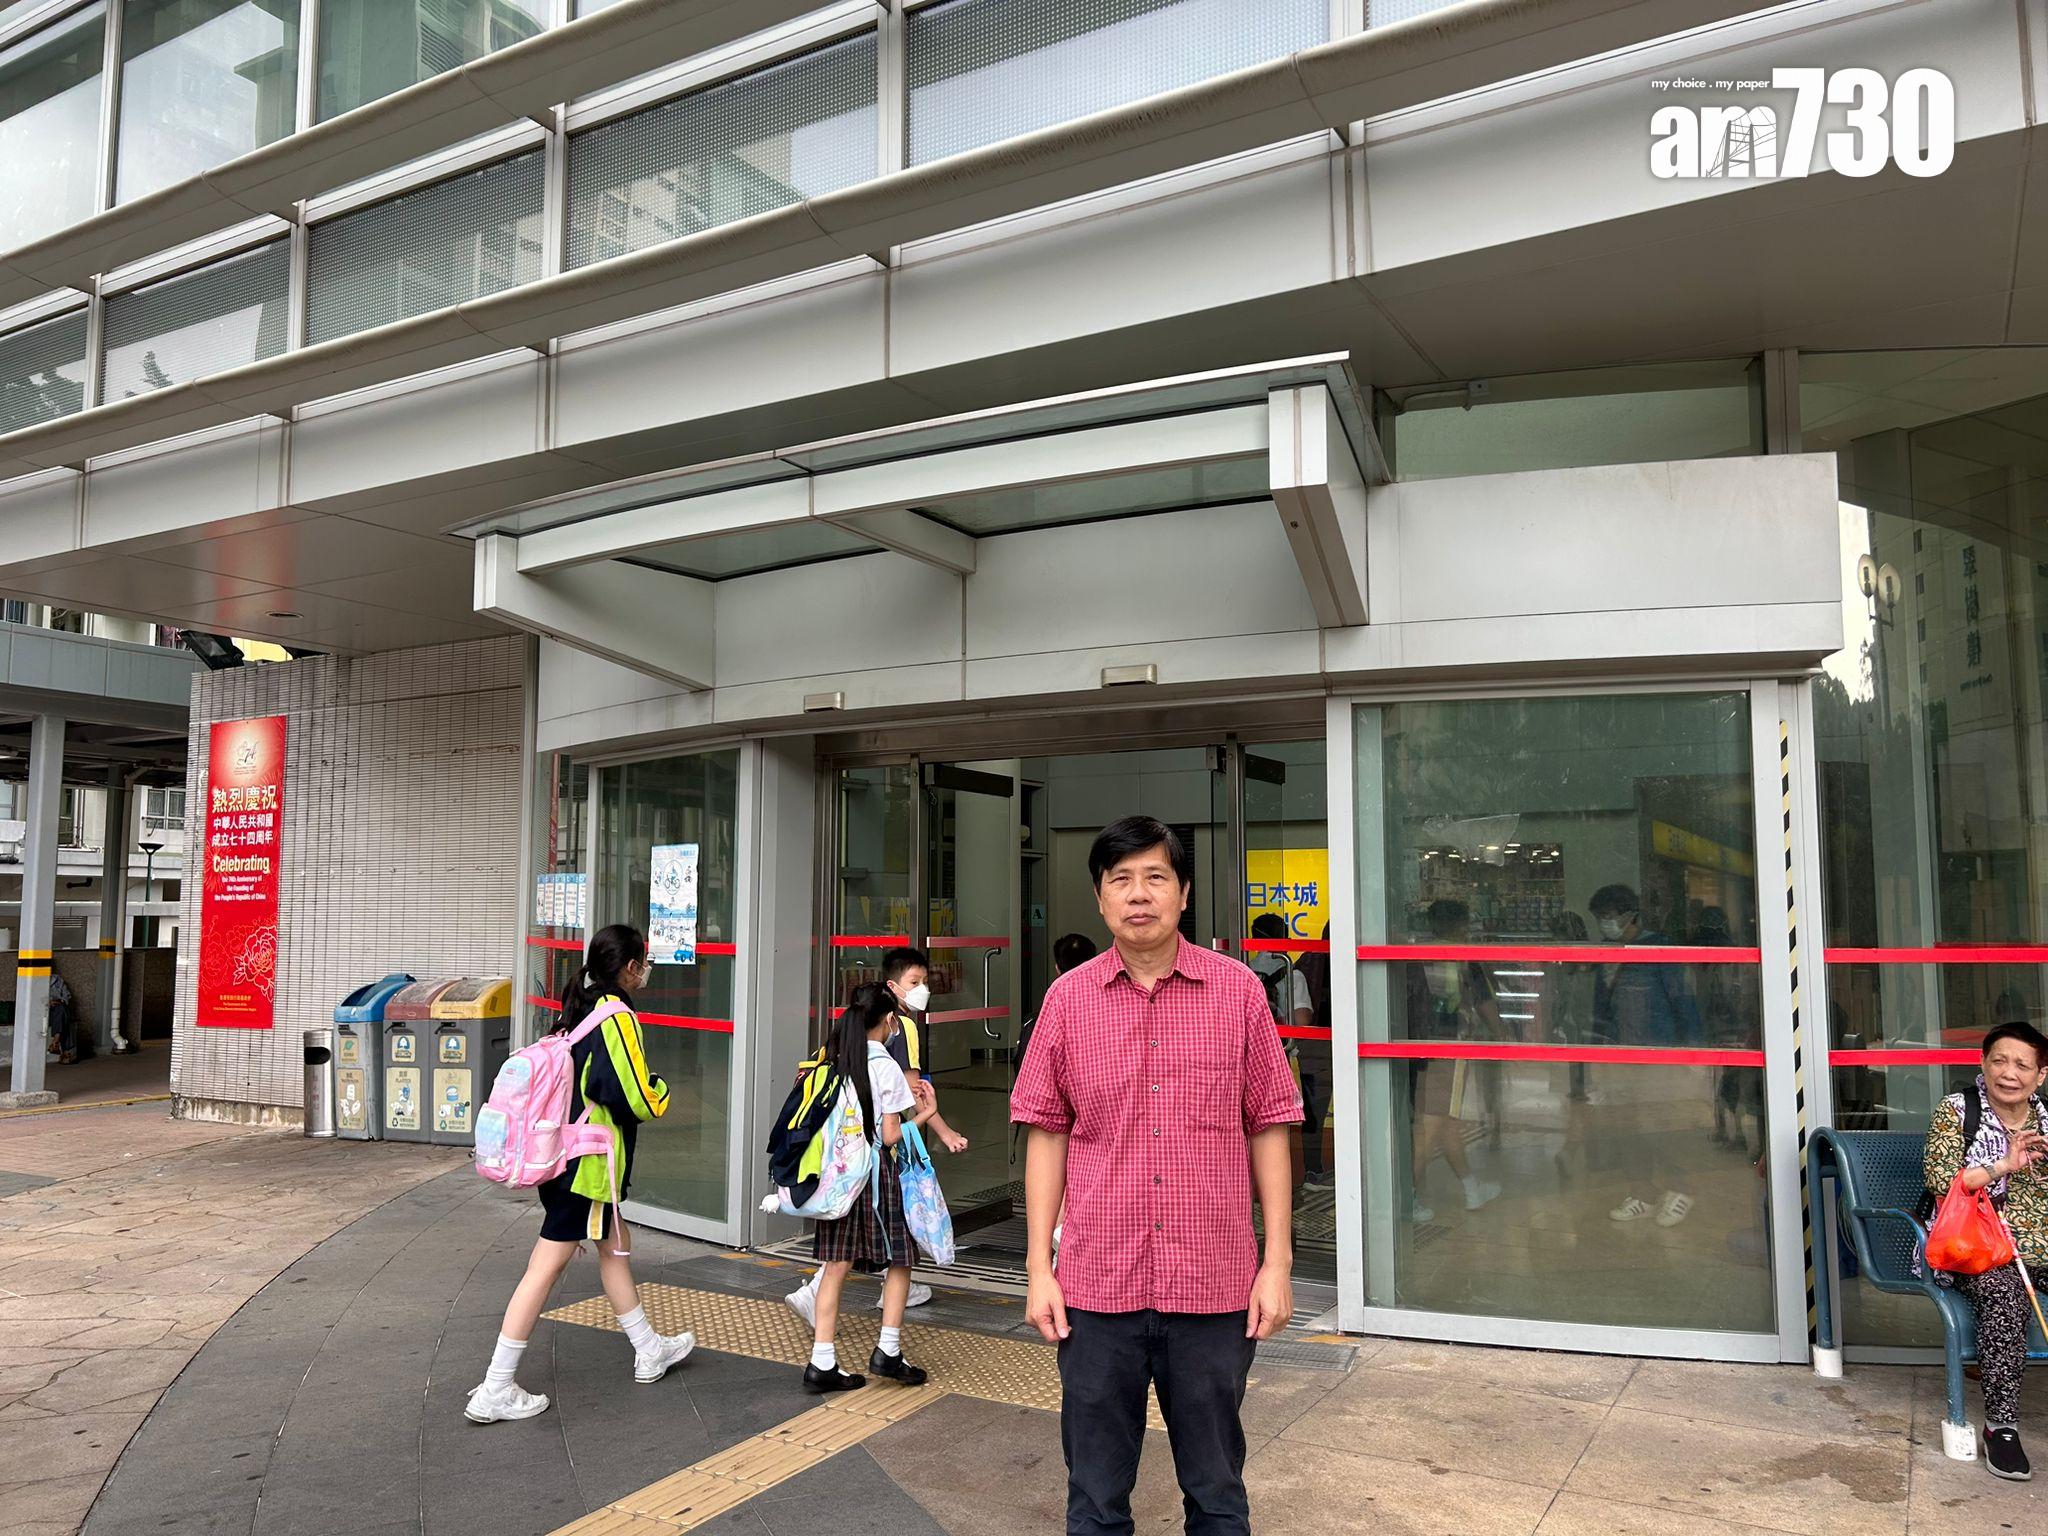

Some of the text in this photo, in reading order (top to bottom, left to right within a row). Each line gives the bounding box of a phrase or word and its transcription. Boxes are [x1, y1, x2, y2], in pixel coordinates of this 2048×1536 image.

[212, 785, 277, 813] 熱烈慶祝
[213, 813, 274, 831] 中華人民共和國
[211, 830, 274, 848] 成立七十四周年
[213, 854, 270, 875] Celebrating
[1247, 881, 1319, 907] 日本城
